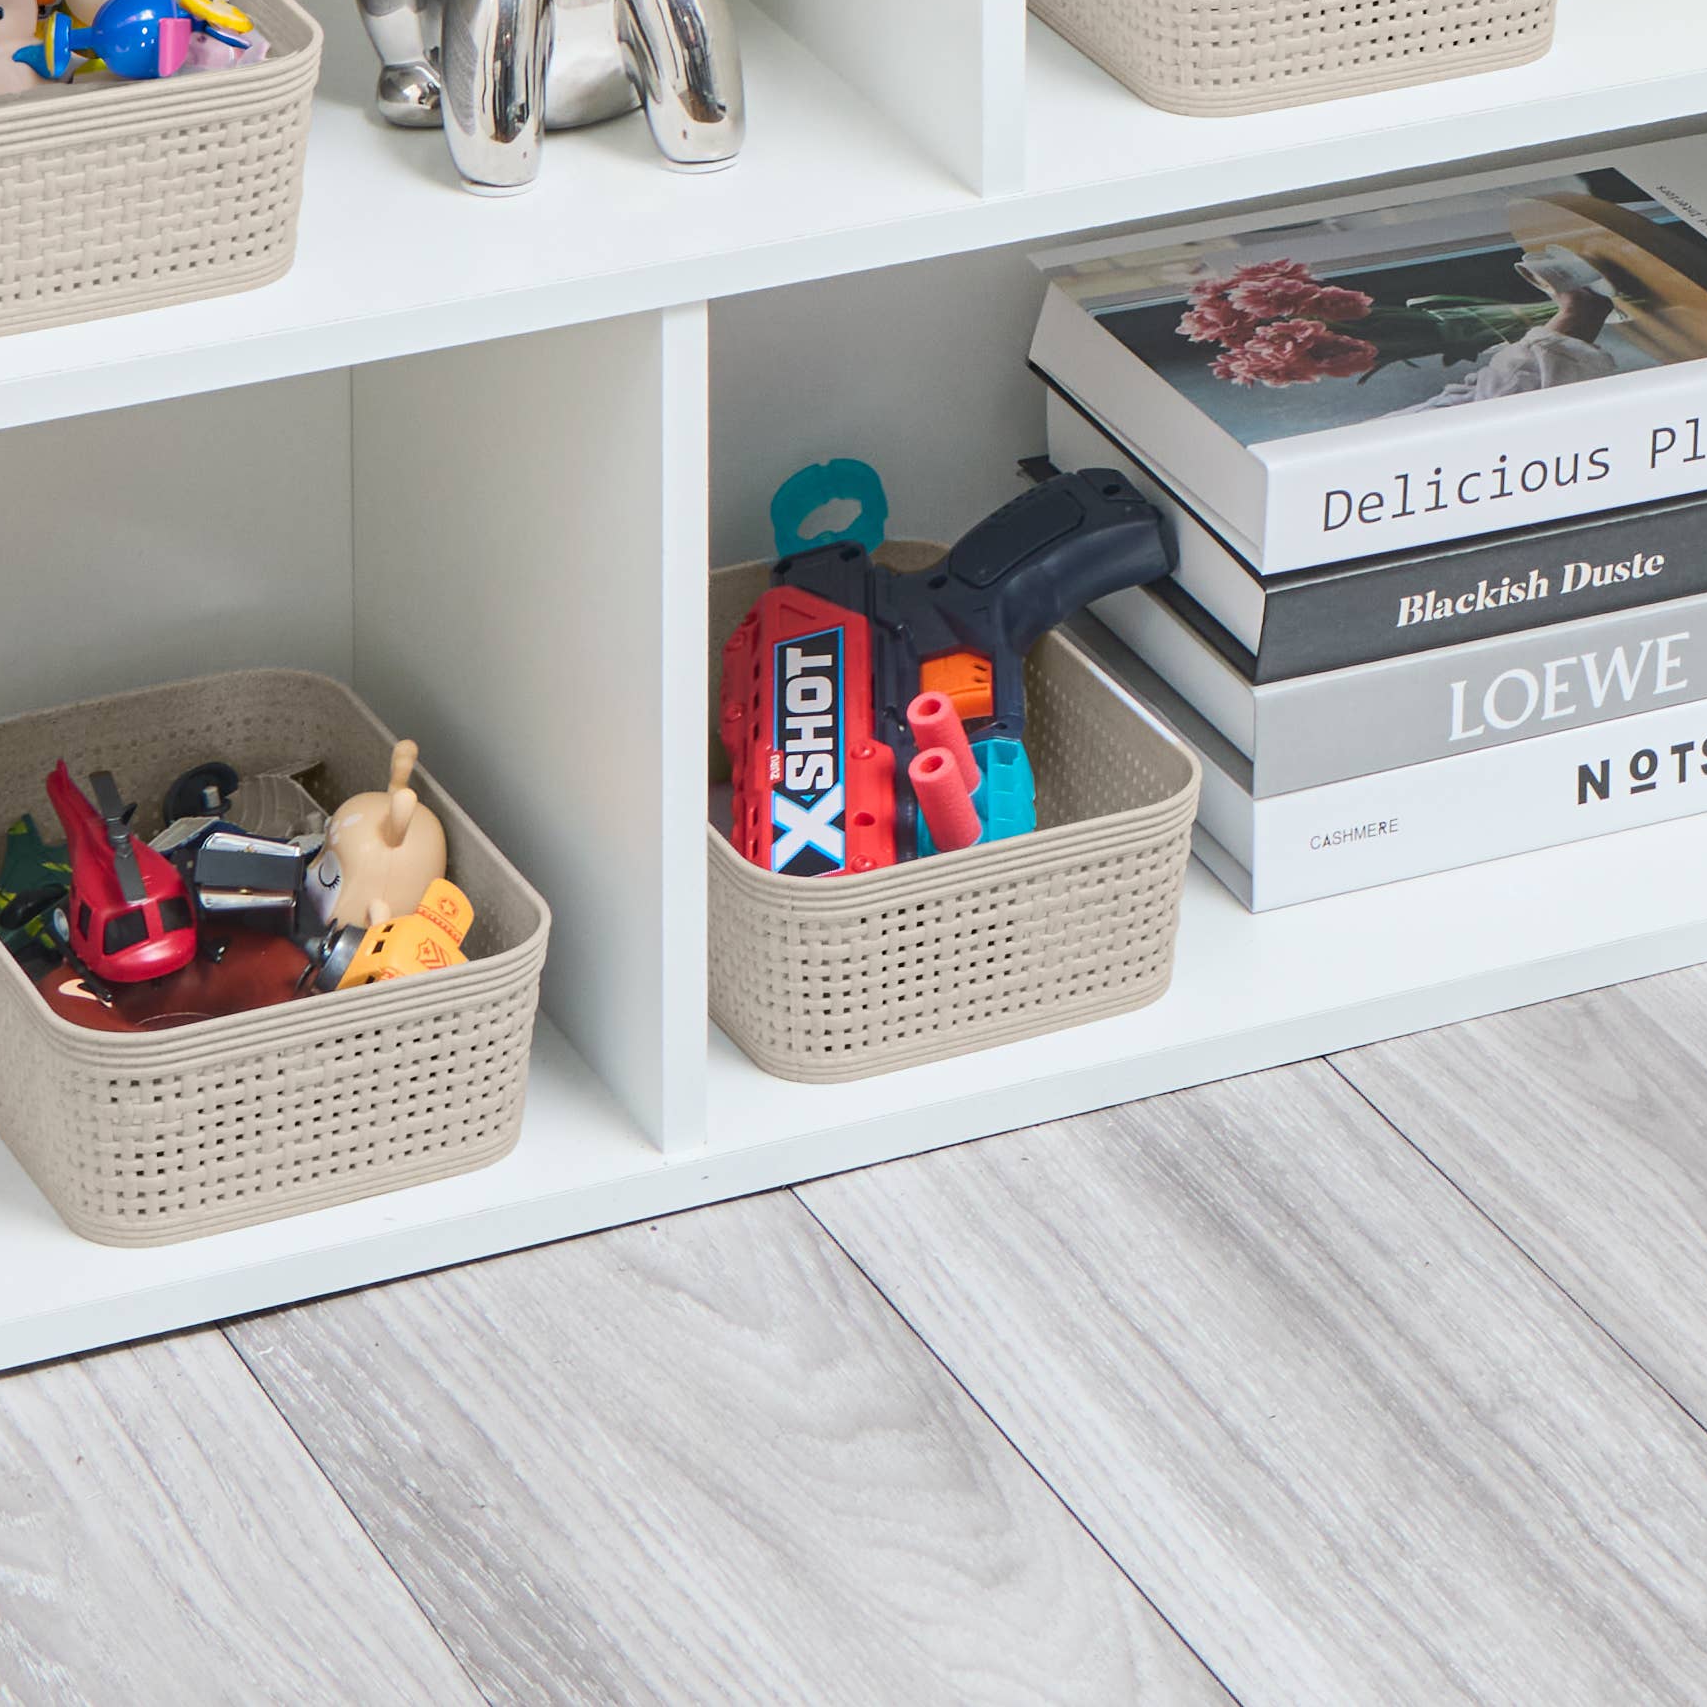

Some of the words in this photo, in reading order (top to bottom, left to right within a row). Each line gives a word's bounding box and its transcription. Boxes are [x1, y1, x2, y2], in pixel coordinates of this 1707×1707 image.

[1655, 184, 1701, 217] Interiors
[1323, 447, 1611, 532] Delicious
[1396, 568, 1550, 628] Blackish
[1560, 552, 1666, 594] Duste
[1448, 631, 1691, 741] LOEWE
[769, 754, 781, 781] ZURU
[1310, 818, 1399, 850] CASHMERE
